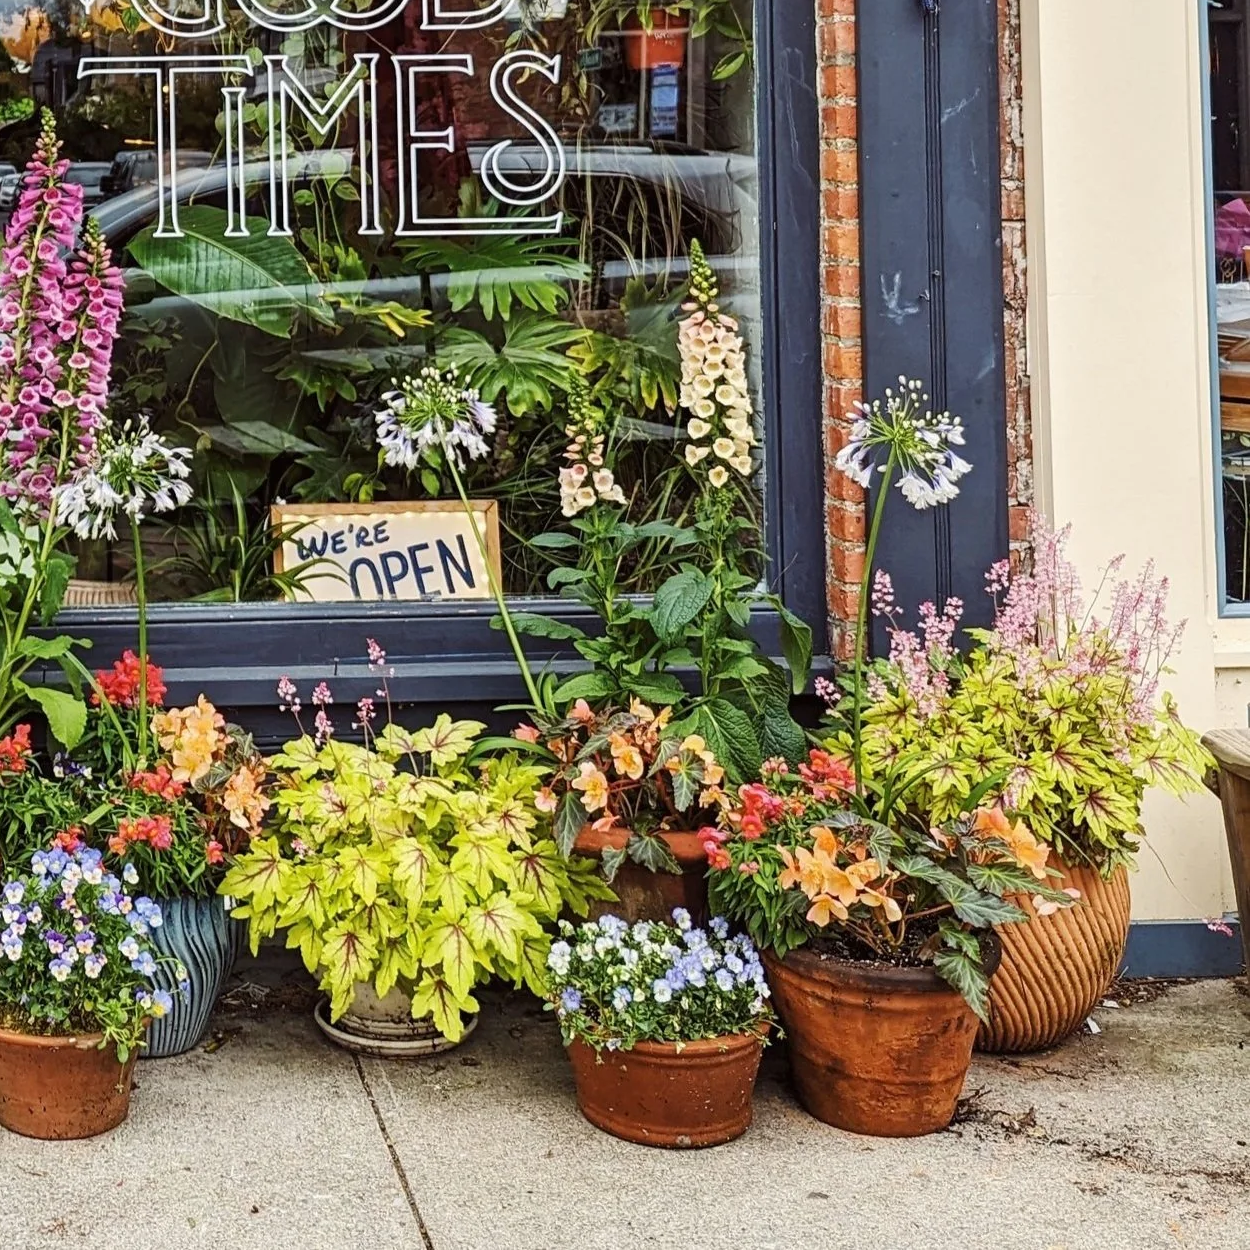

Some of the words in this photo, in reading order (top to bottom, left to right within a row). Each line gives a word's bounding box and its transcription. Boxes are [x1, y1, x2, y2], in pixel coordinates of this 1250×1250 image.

[77, 50, 565, 238] TIMES
[297, 520, 390, 561] WE'RE
[349, 534, 476, 600] OPEN
